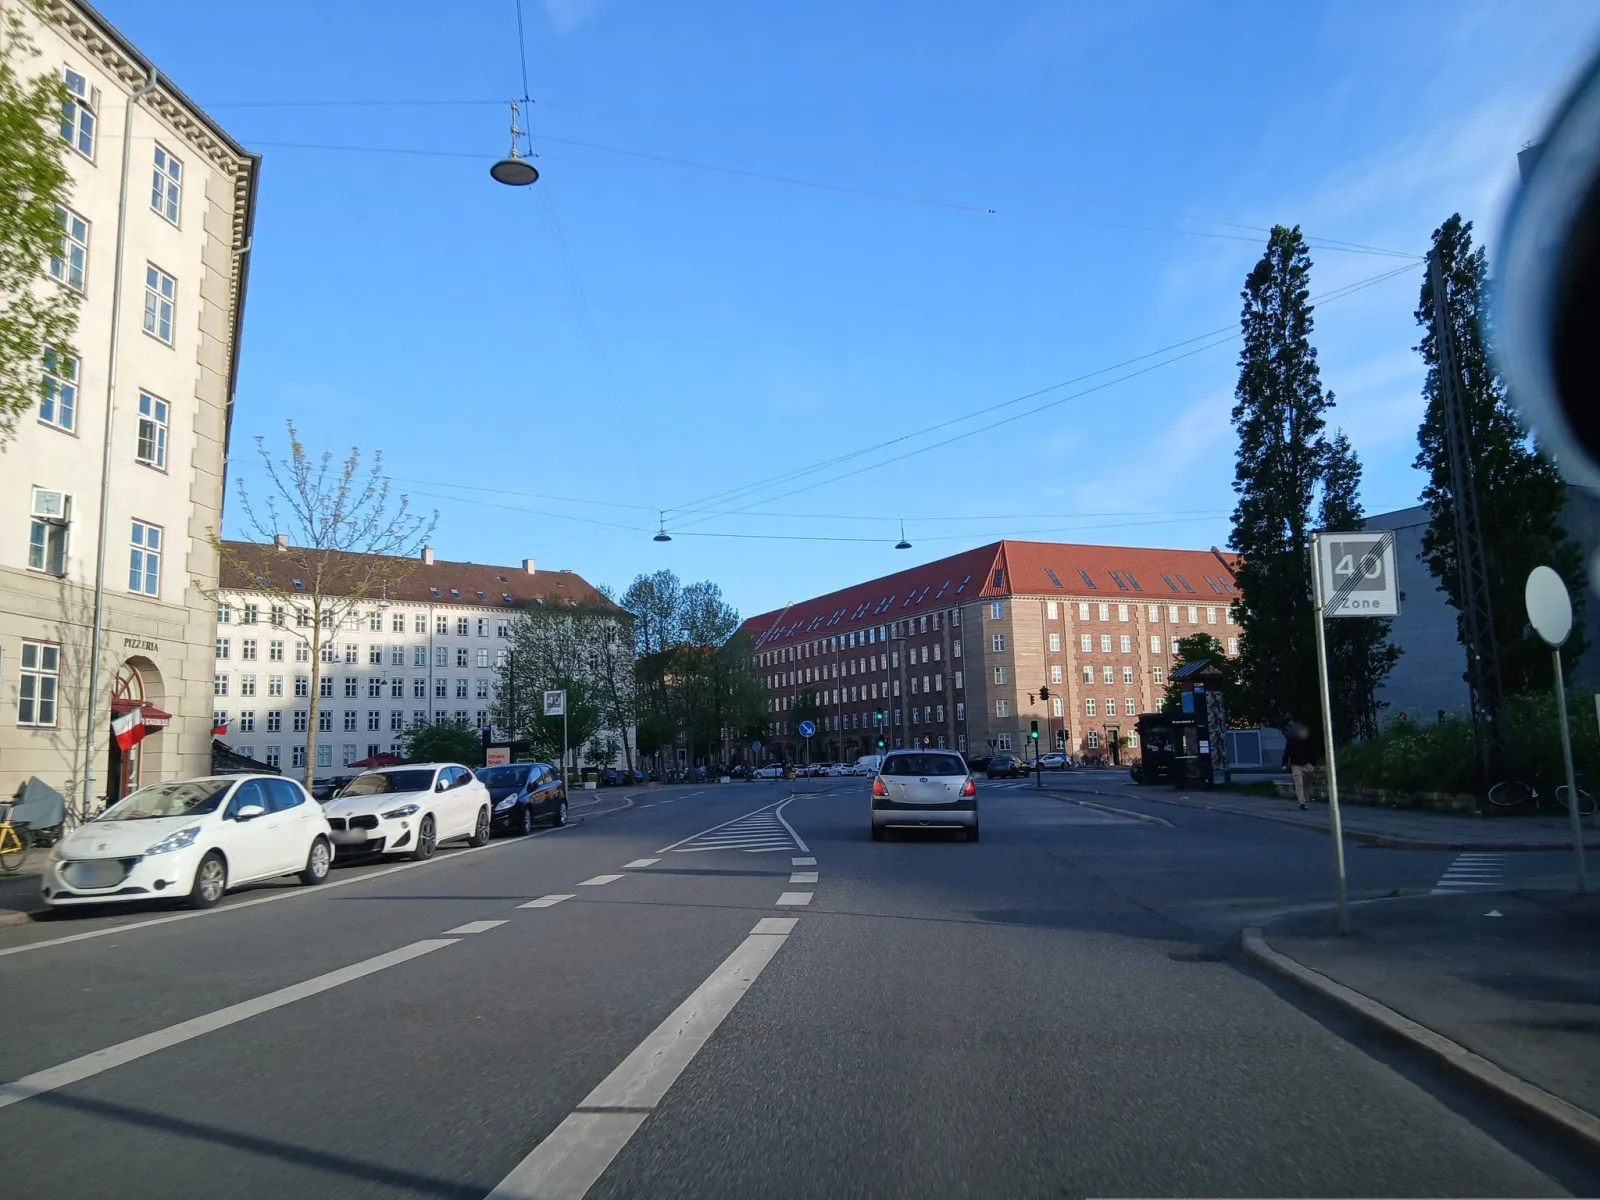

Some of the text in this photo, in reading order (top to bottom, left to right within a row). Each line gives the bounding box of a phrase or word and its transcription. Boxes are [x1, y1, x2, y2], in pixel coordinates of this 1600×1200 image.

[1335, 554, 1382, 579] 40
[1341, 598, 1381, 609] Zone
[124, 637, 159, 651] PIZZERIA
[547, 696, 561, 705] 40
